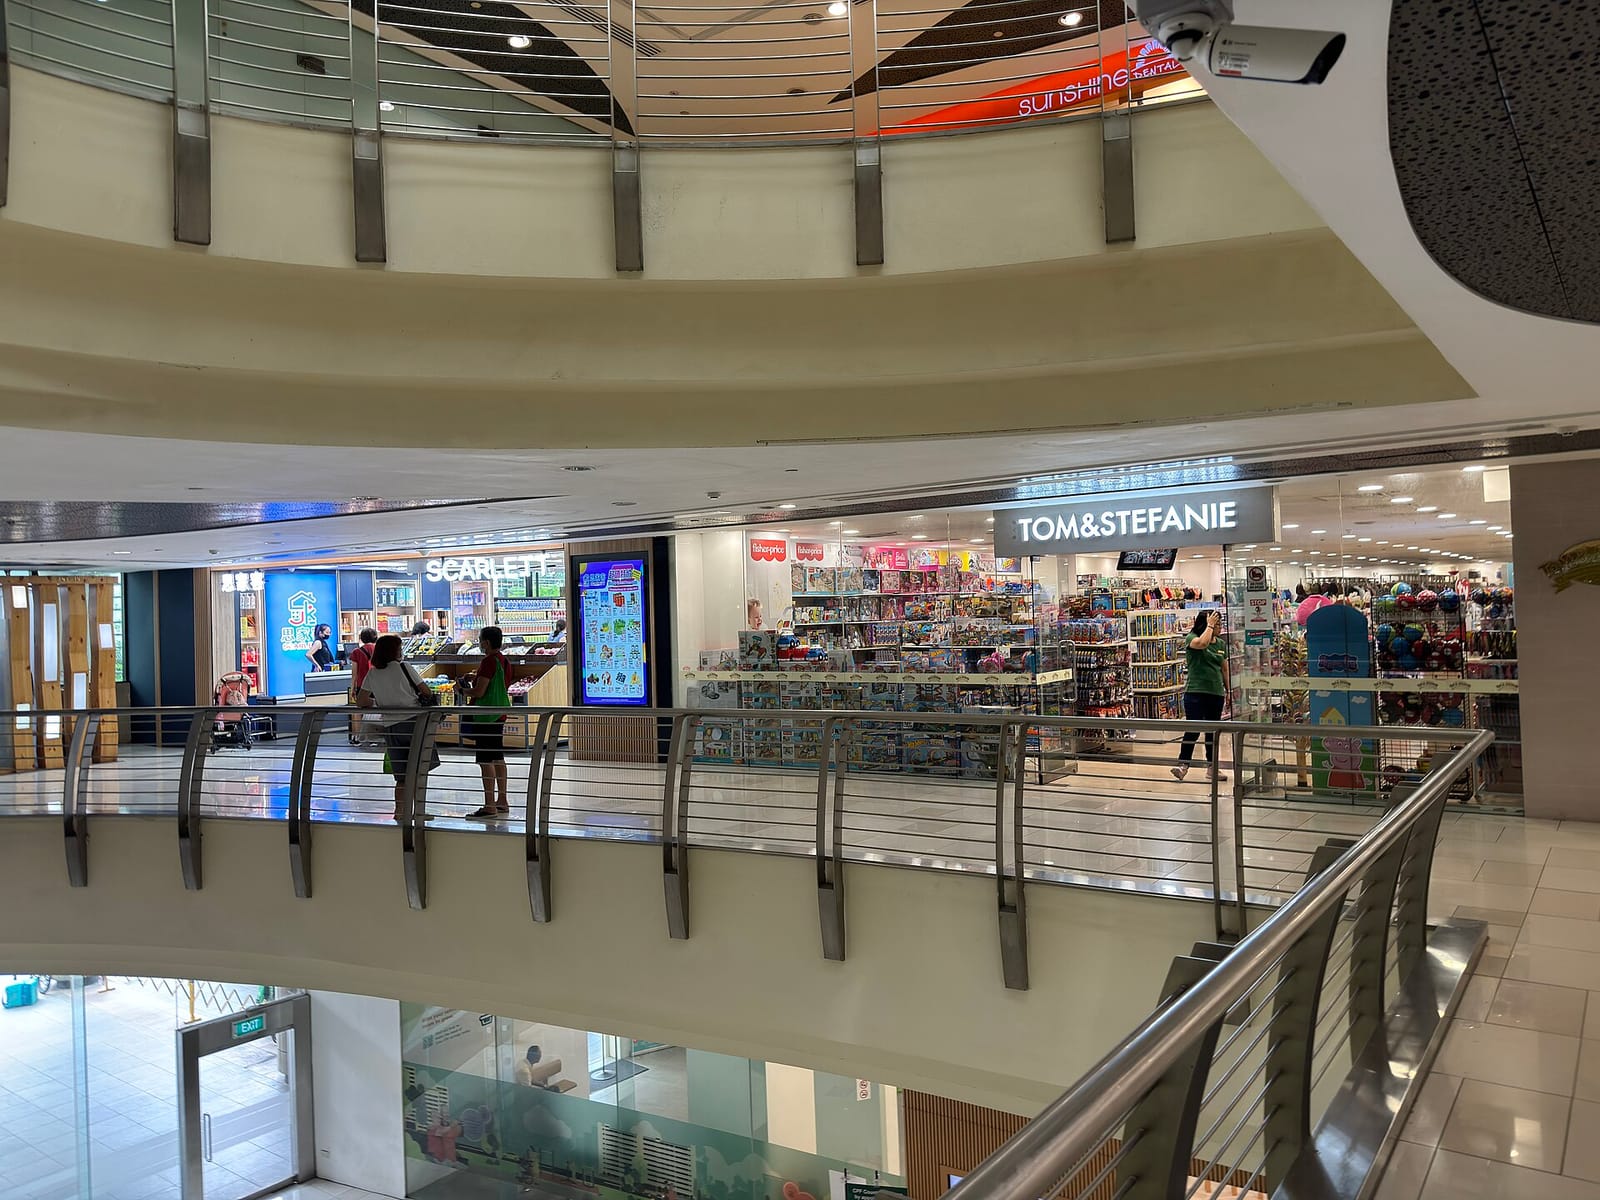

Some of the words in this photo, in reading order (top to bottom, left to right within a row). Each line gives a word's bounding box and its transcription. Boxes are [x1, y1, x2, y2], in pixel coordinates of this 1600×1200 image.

[1133, 60, 1180, 79] DENTAL
[1018, 501, 1237, 542] TOM&STEFANIE
[752, 543, 785, 555] fisher-price
[426, 554, 548, 582] SCARLETT
[281, 627, 315, 642] 思家
[241, 1019, 259, 1033] EXIT
